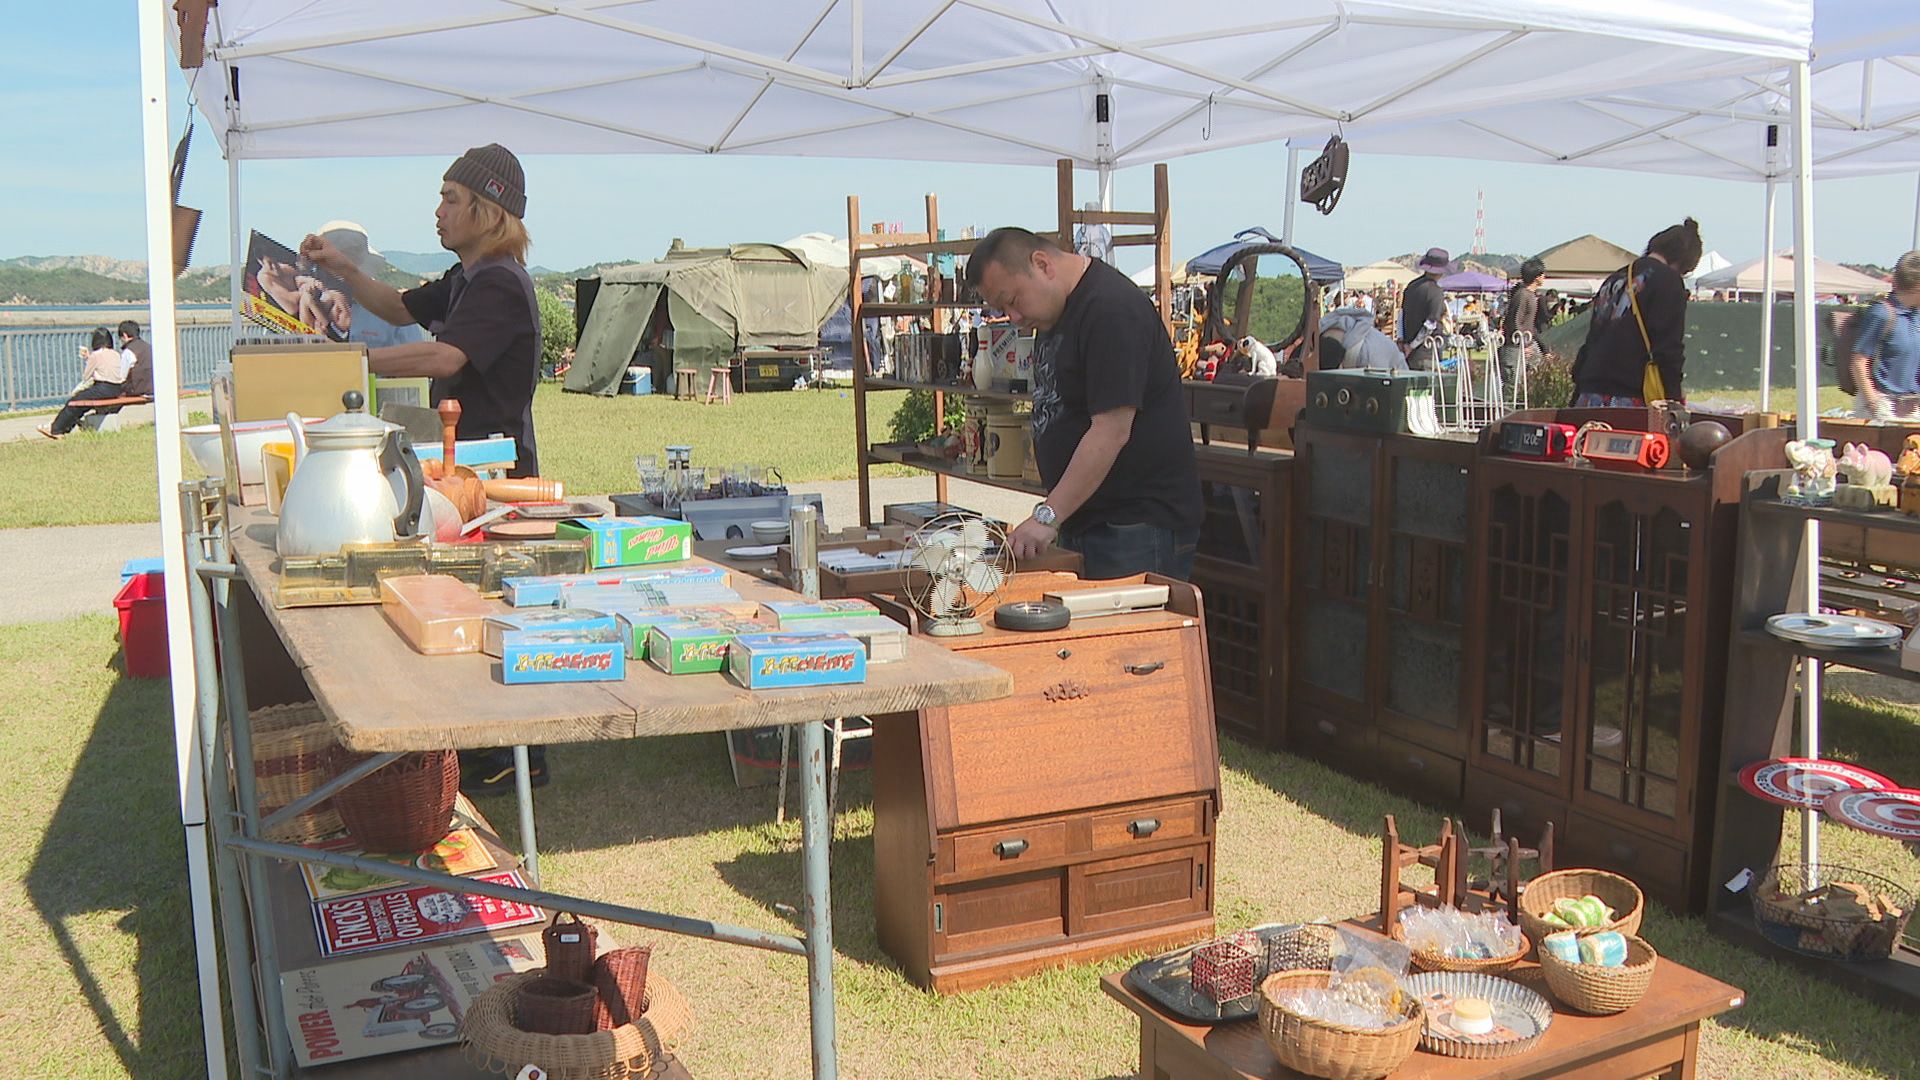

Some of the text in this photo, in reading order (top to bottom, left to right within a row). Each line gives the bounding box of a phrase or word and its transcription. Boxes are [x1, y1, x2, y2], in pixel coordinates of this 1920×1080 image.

[993, 329, 1017, 358] PREMIUM
[628, 527, 664, 549] Chimes
[645, 535, 679, 560] Wind
[514, 650, 613, 674] ウルトラマンシリーズ
[760, 651, 856, 676] ウルトラマンシリーズ
[329, 900, 378, 949] FINCK'S
[386, 892, 424, 938] OVERALLS
[298, 1009, 343, 1060] POWER
